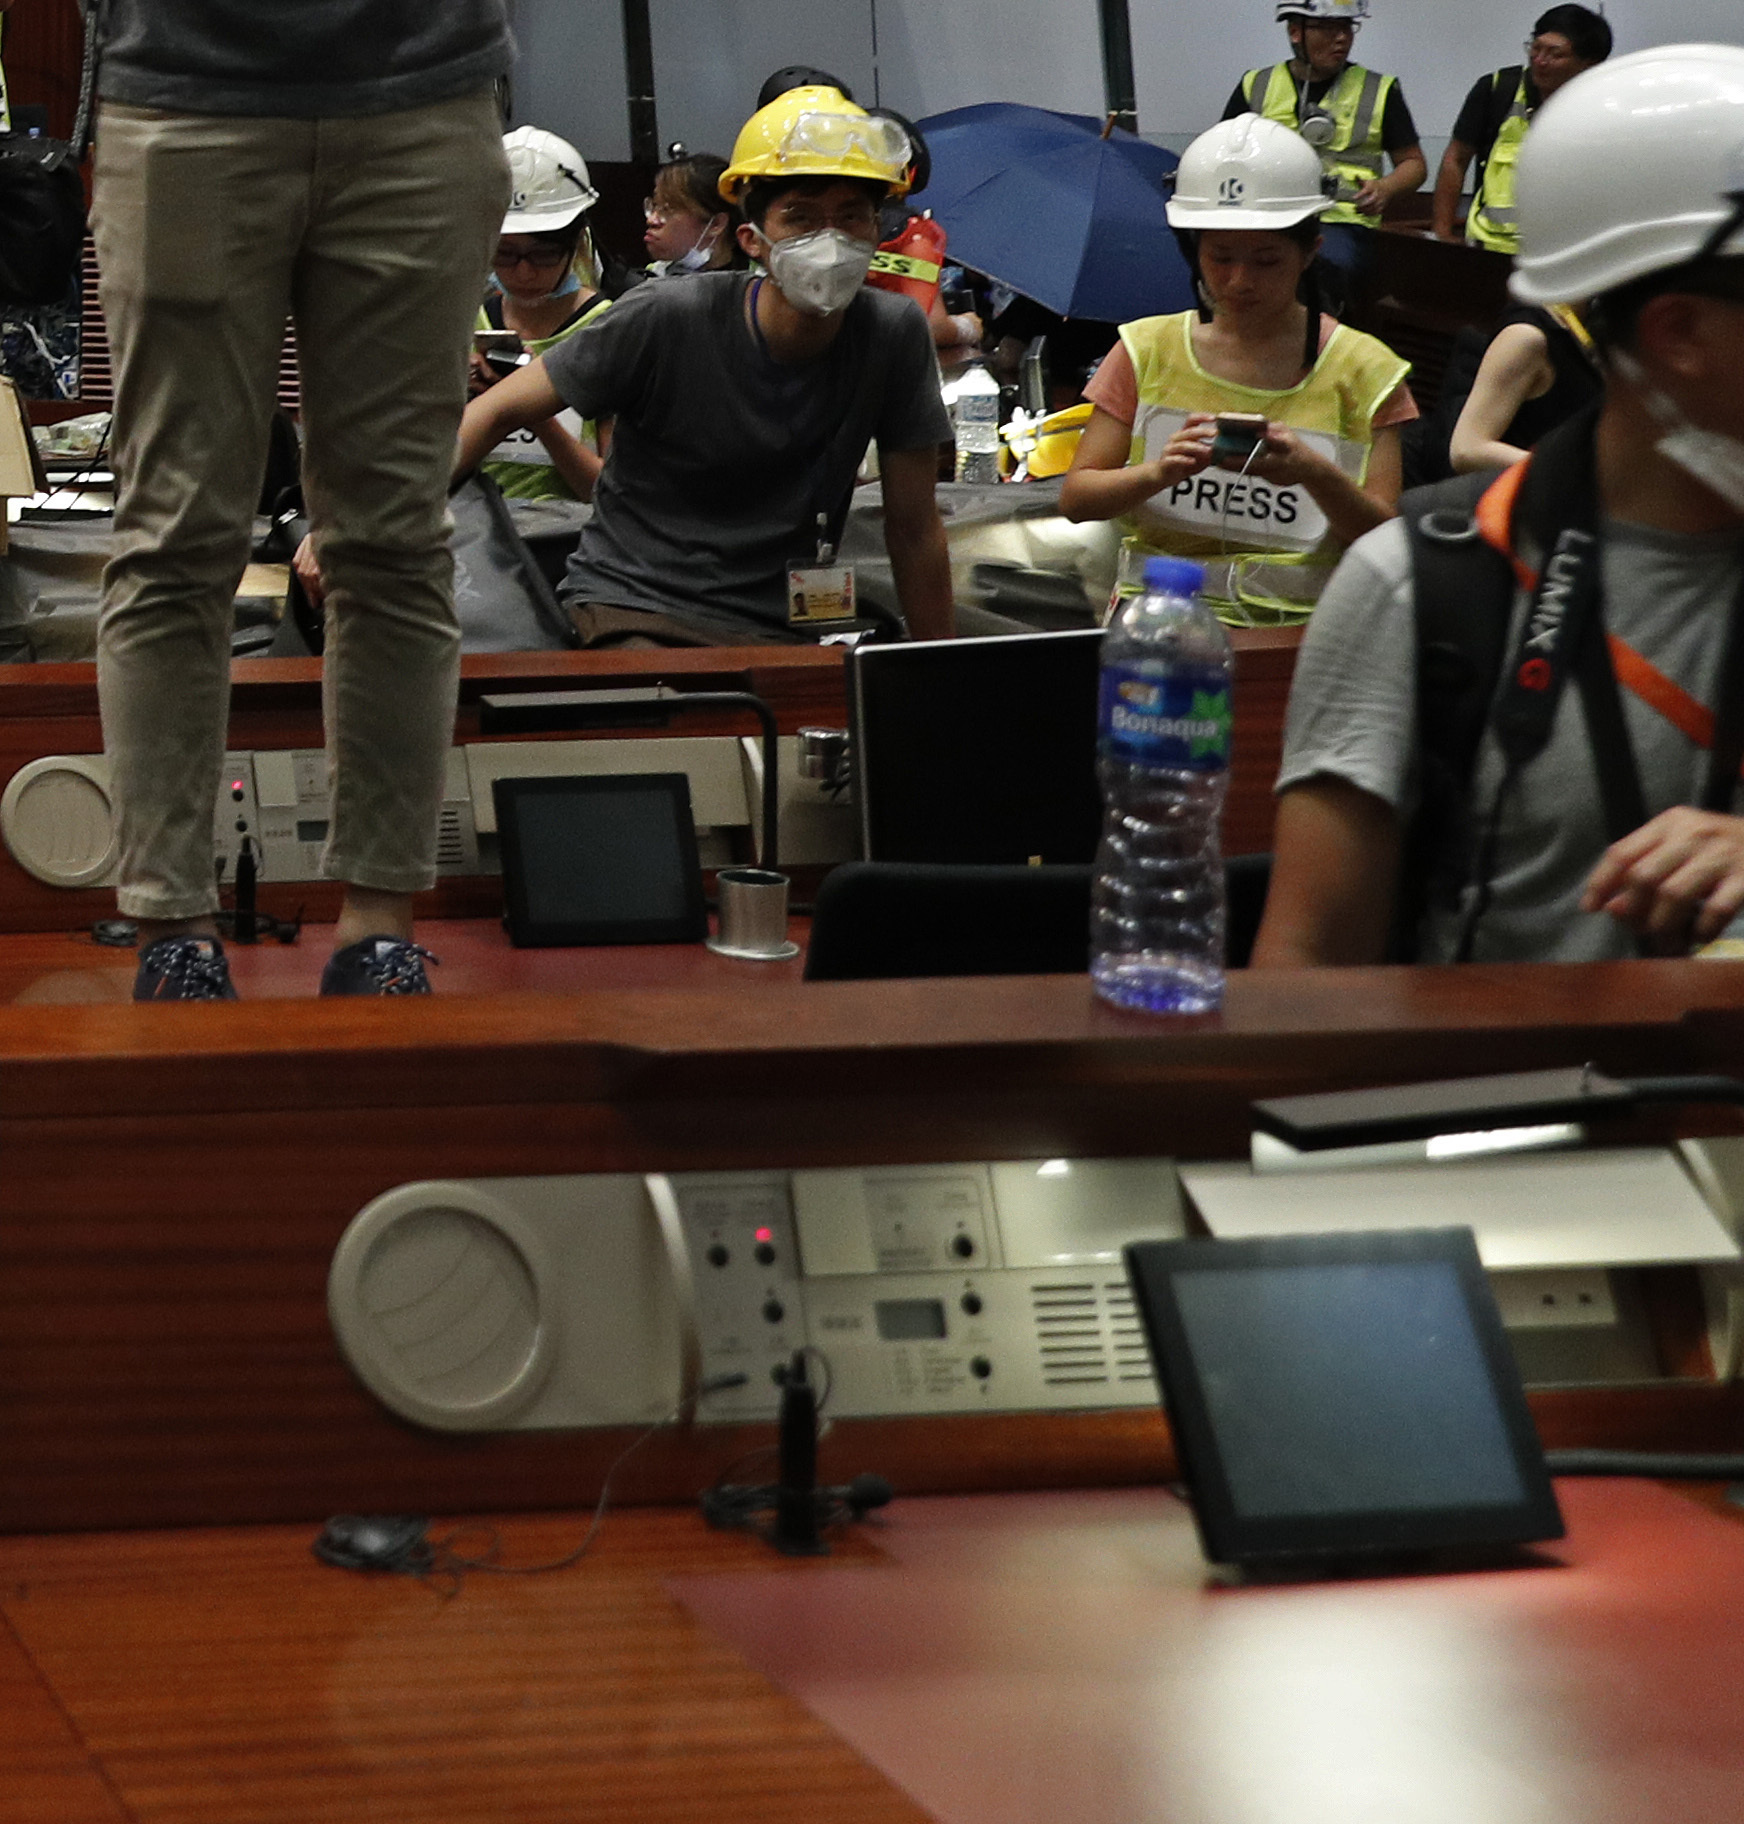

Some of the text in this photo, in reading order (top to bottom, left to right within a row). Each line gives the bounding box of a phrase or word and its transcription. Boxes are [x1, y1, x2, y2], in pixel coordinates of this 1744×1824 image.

[1170, 477, 1298, 524] PRESS
[1524, 527, 1595, 654] LUMIX
[1111, 704, 1218, 741] Bonaqua
